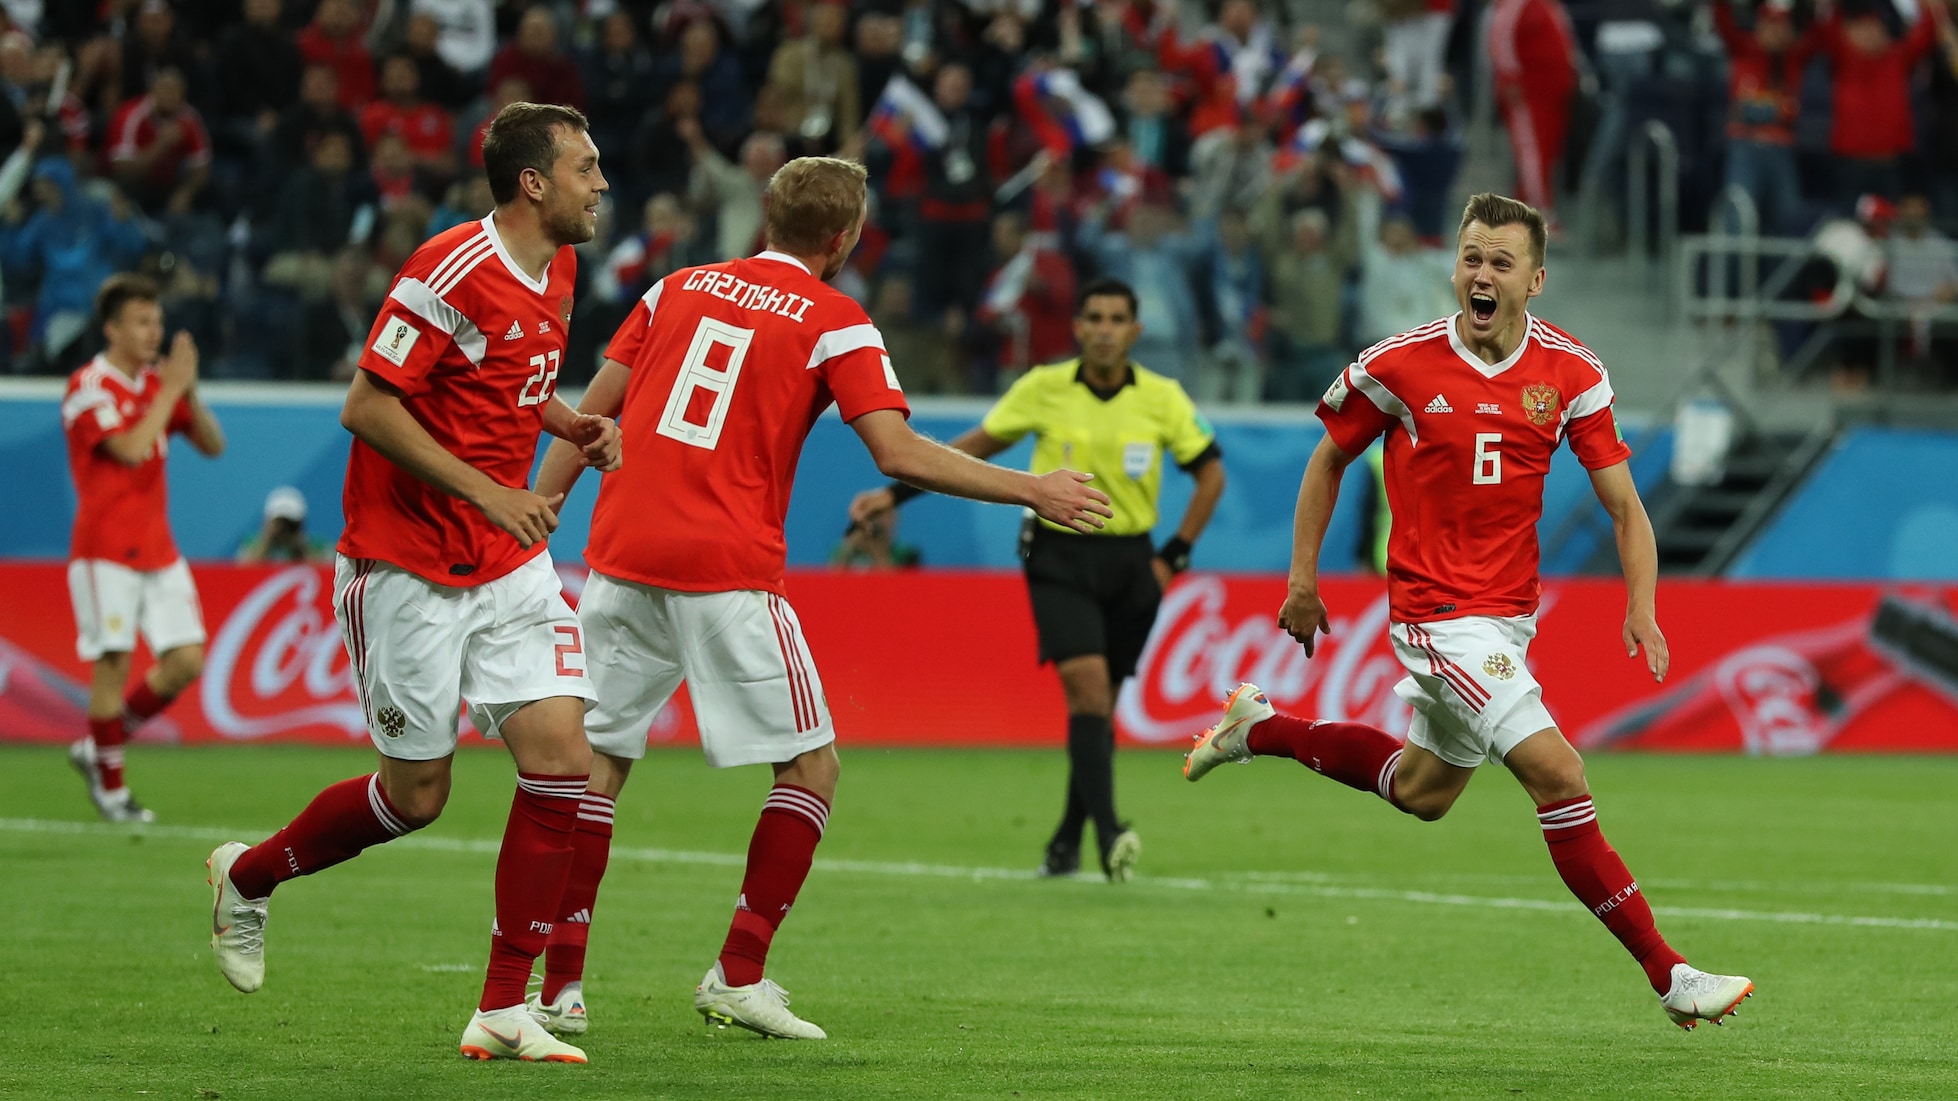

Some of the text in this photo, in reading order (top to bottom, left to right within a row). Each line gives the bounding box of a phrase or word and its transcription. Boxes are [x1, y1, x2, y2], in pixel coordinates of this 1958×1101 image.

[682, 269, 815, 324] GAZINSKII
[504, 331, 525, 341] adidas
[517, 349, 560, 408] 22
[656, 315, 756, 451] 8
[1472, 432, 1502, 485] 6
[553, 625, 584, 678] 2
[1594, 881, 1640, 917] РОССИЯ
